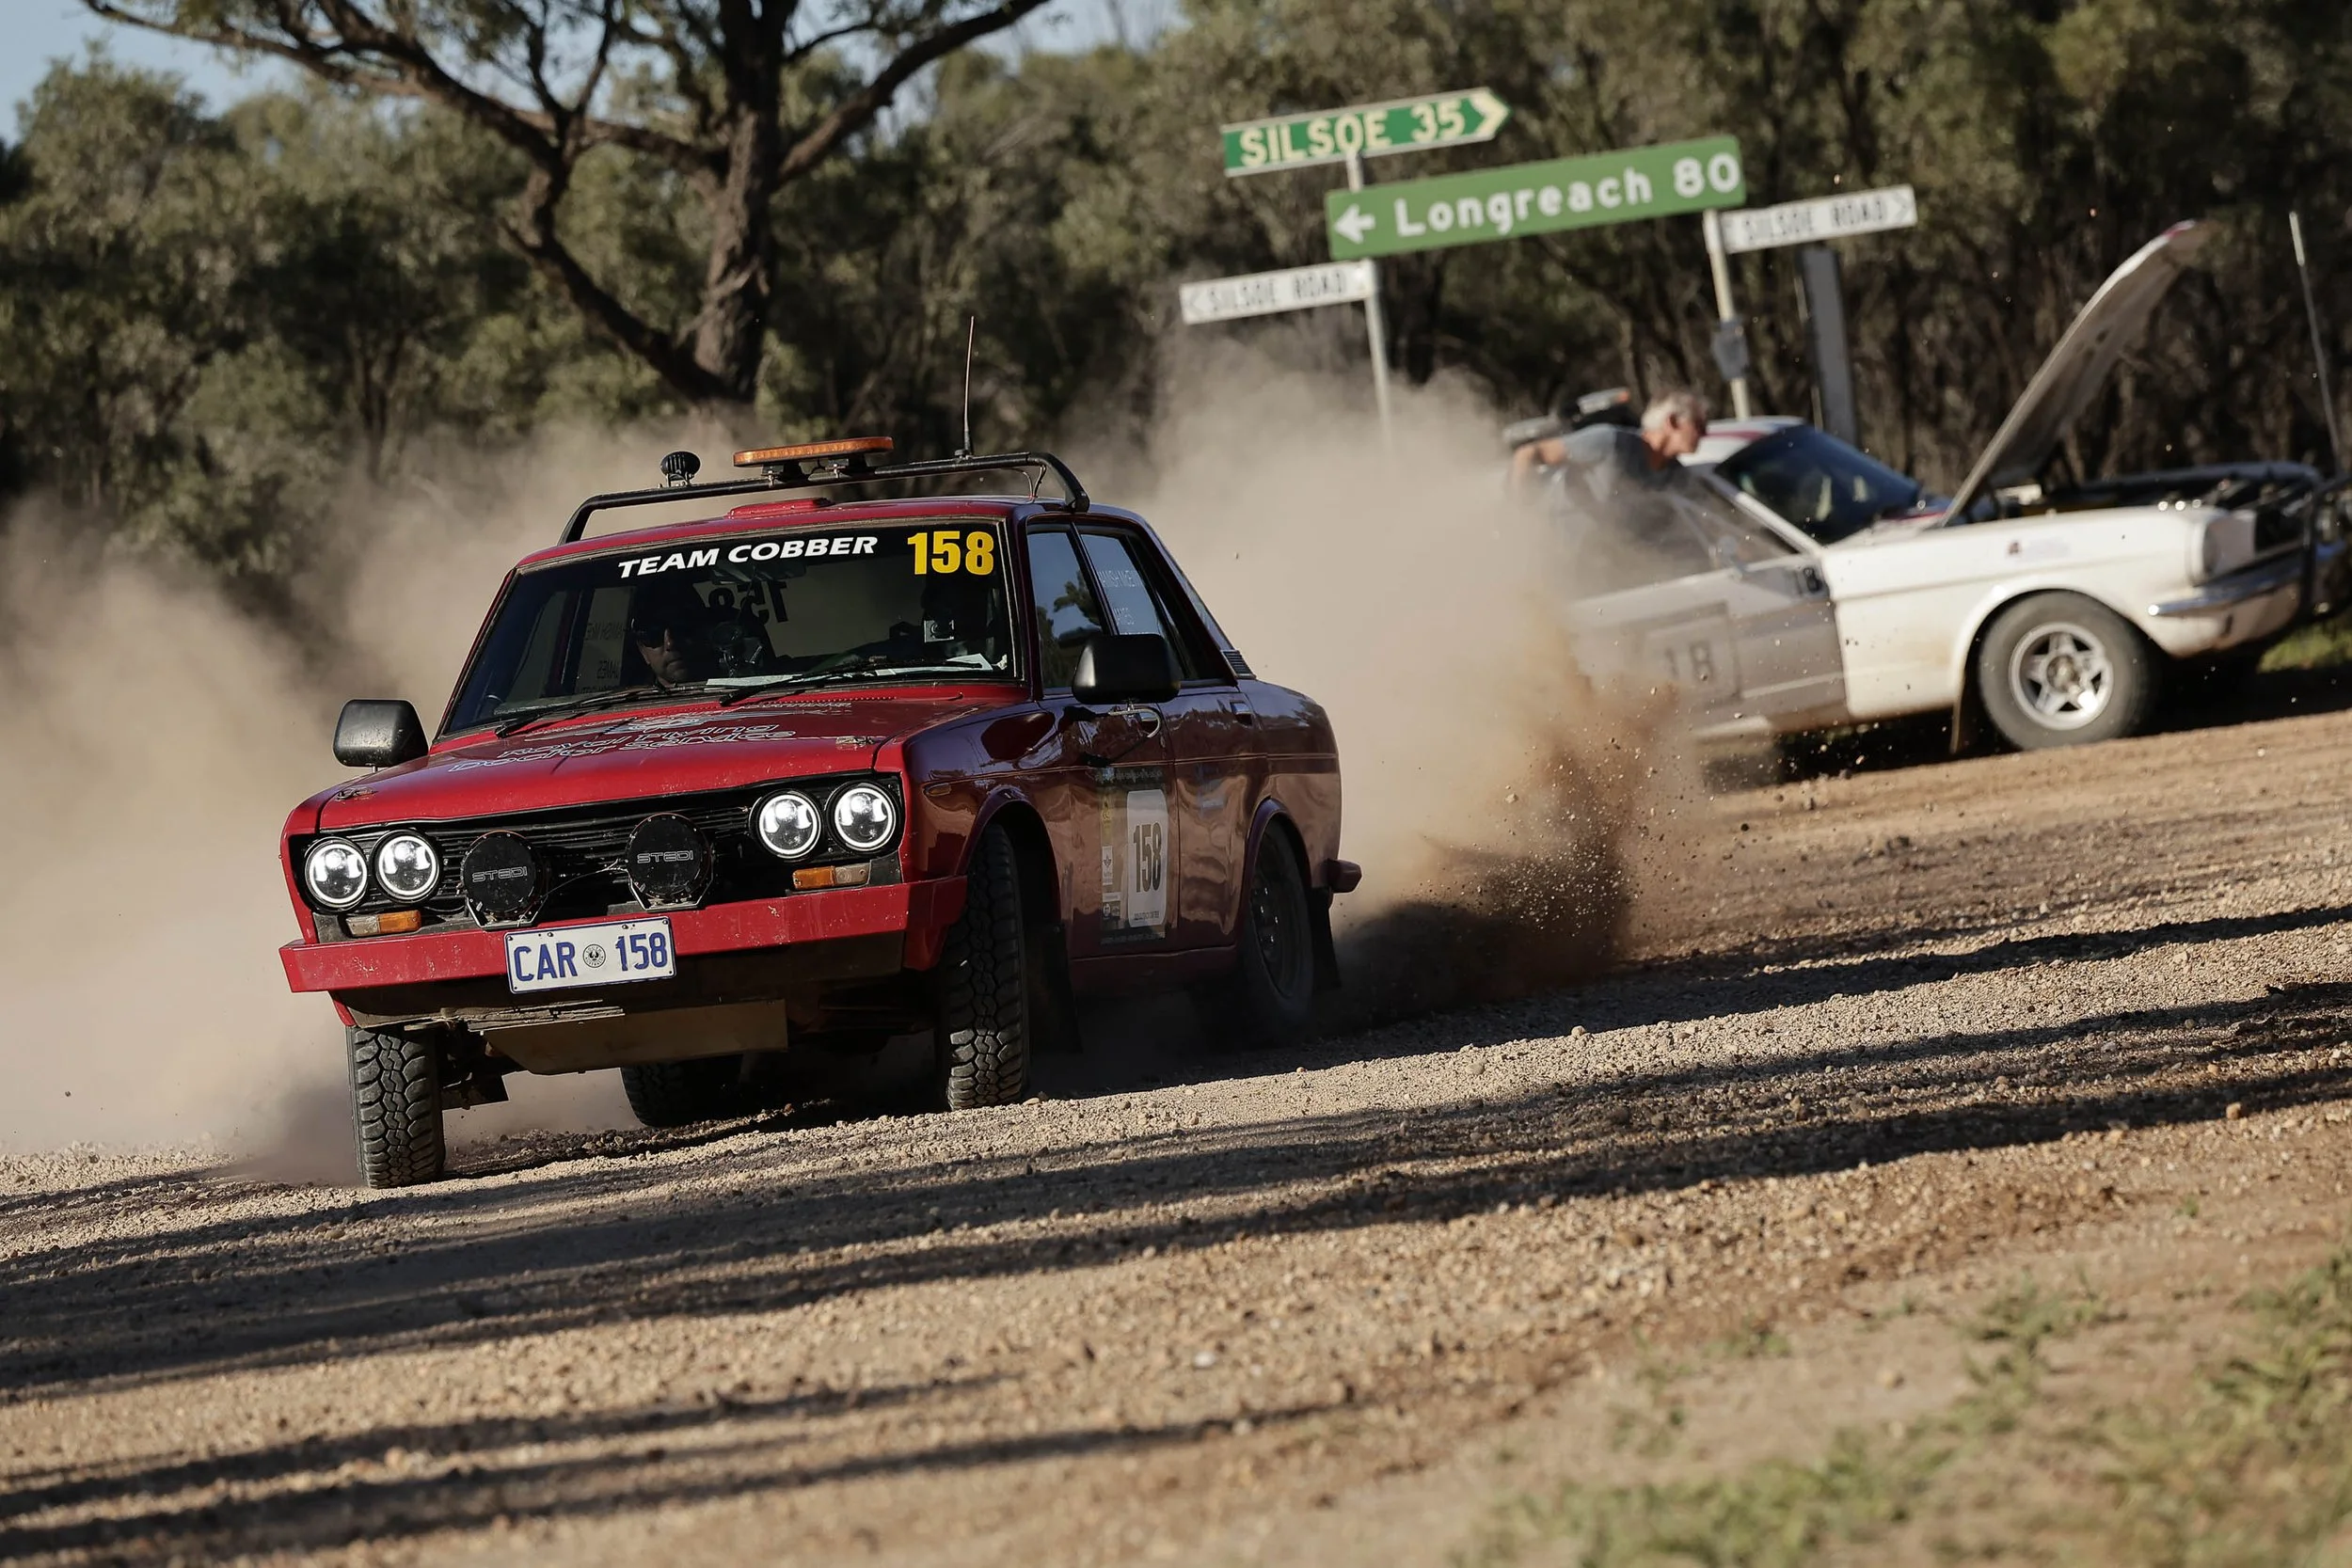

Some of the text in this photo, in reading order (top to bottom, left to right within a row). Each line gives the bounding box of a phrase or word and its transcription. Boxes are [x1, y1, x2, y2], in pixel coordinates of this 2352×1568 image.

[1240, 98, 1465, 167] SILSOE 35
[1393, 152, 1741, 235] Longreach 80
[1834, 199, 1886, 226] ROAD
[1295, 270, 1346, 299] ROAD
[618, 536, 879, 578] TEAM COBBER
[908, 531, 994, 576] 158
[448, 729, 797, 772] Doctor Service
[496, 736, 632, 758] Royal
[472, 866, 528, 883] STEDI
[637, 850, 694, 864] STEDI
[1134, 823, 1162, 893] 158
[514, 932, 668, 981] CAR 158
